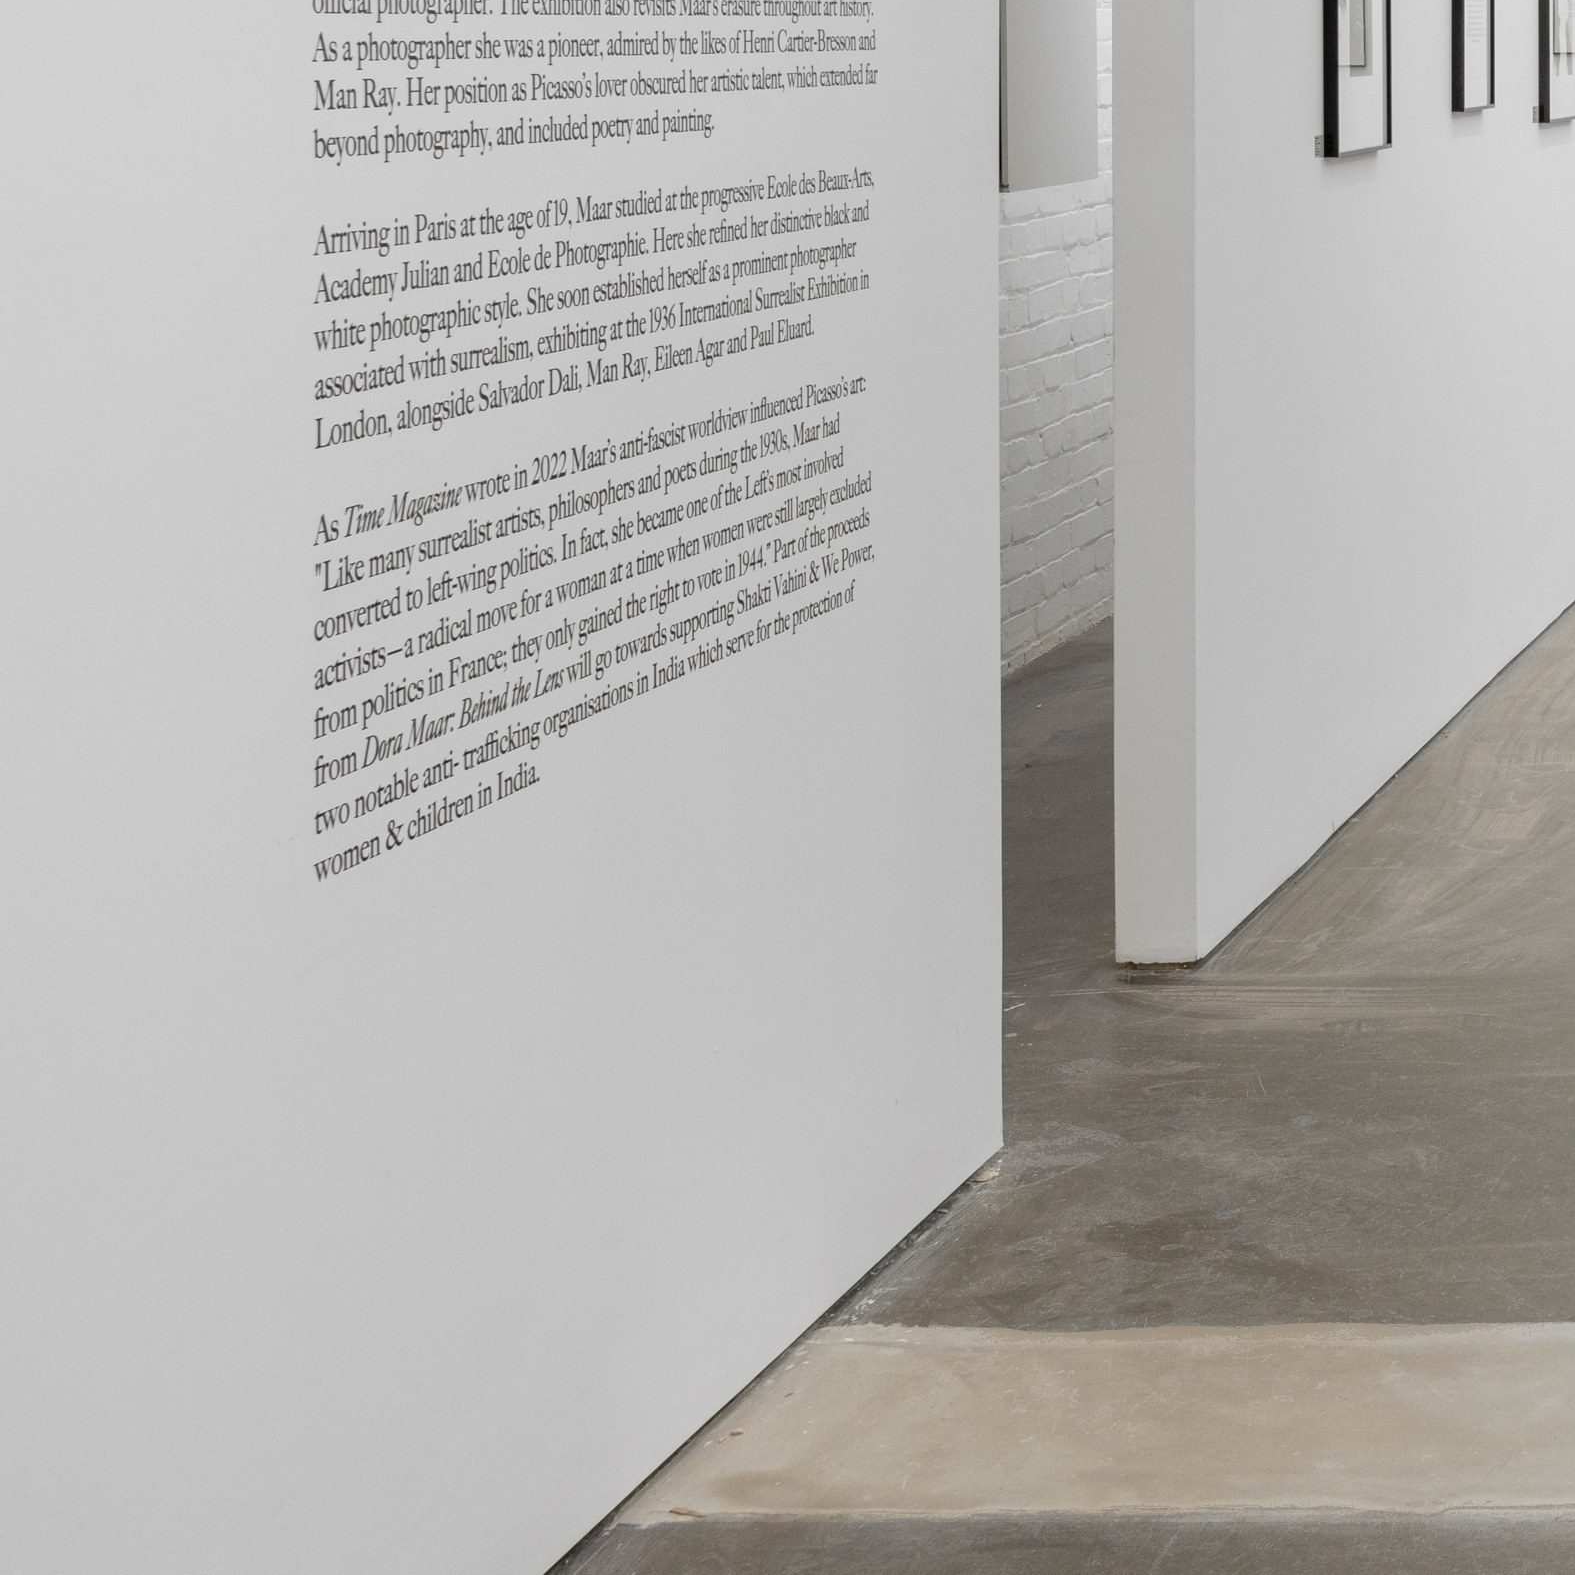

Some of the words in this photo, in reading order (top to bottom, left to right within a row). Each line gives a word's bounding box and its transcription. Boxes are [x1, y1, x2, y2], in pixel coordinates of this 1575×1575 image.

[313, 220, 391, 258] Arriving
[393, 217, 411, 247] in
[413, 212, 457, 244] Paris
[460, 215, 477, 238] at
[478, 206, 505, 236] the
[507, 210, 534, 240] age
[536, 199, 553, 229] of
[553, 198, 573, 230] 19,
[575, 195, 614, 224] Maar
[615, 187, 663, 219] studied
[664, 191, 678, 212] at
[679, 185, 699, 211] the
[700, 178, 765, 216] progressive
[766, 173, 798, 200] Ecole
[798, 171, 817, 196] des
[817, 166, 875, 193] Beaux-Arts,
[314, 408, 393, 450] London,
[396, 387, 475, 432] alongside
[478, 374, 546, 412] Salvador
[547, 364, 583, 397] Dali,
[586, 357, 619, 388] Man
[621, 352, 652, 383] Ray,
[654, 343, 693, 373] Eileen
[694, 337, 726, 368] Agar
[726, 327, 748, 356] and
[749, 321, 775, 350] Paul
[776, 313, 815, 344] Eluard.
[312, 513, 340, 547] As
[343, 503, 386, 539] Time
[385, 481, 463, 527] Magazine
[463, 473, 511, 503] wrote
[513, 463, 529, 491] in
[530, 449, 568, 486] 2022
[619, 422, 687, 461] anti-fascist
[687, 406, 749, 441] worldview
[749, 386, 804, 425] influenced
[849, 376, 867, 396] art:
[313, 585, 402, 642] converted
[405, 588, 424, 612] to
[426, 563, 498, 606] left-wing
[499, 543, 558, 591] politics.
[560, 532, 578, 562] In
[579, 526, 609, 556] fact,
[611, 515, 634, 545] she
[635, 504, 685, 536] became
[685, 496, 709, 519] one
[710, 483, 724, 511] of
[723, 481, 743, 507] the
[775, 464, 803, 490] most
[803, 444, 845, 481] involved
[313, 802, 351, 835] two
[353, 767, 420, 819] notable
[422, 749, 460, 789] anti-
[462, 720, 541, 771] trafficking
[542, 681, 634, 739] organisations
[636, 670, 650, 697] in
[651, 655, 686, 690] India
[686, 637, 724, 673] which
[725, 629, 755, 658] serve
[755, 618, 773, 645] for
[773, 610, 791, 636] the
[791, 590, 843, 636] protection
[844, 578, 856, 605] of
[313, 835, 382, 883] women
[385, 819, 405, 851] &
[406, 793, 475, 841] children
[477, 781, 493, 810] in
[496, 761, 541, 801] India.
